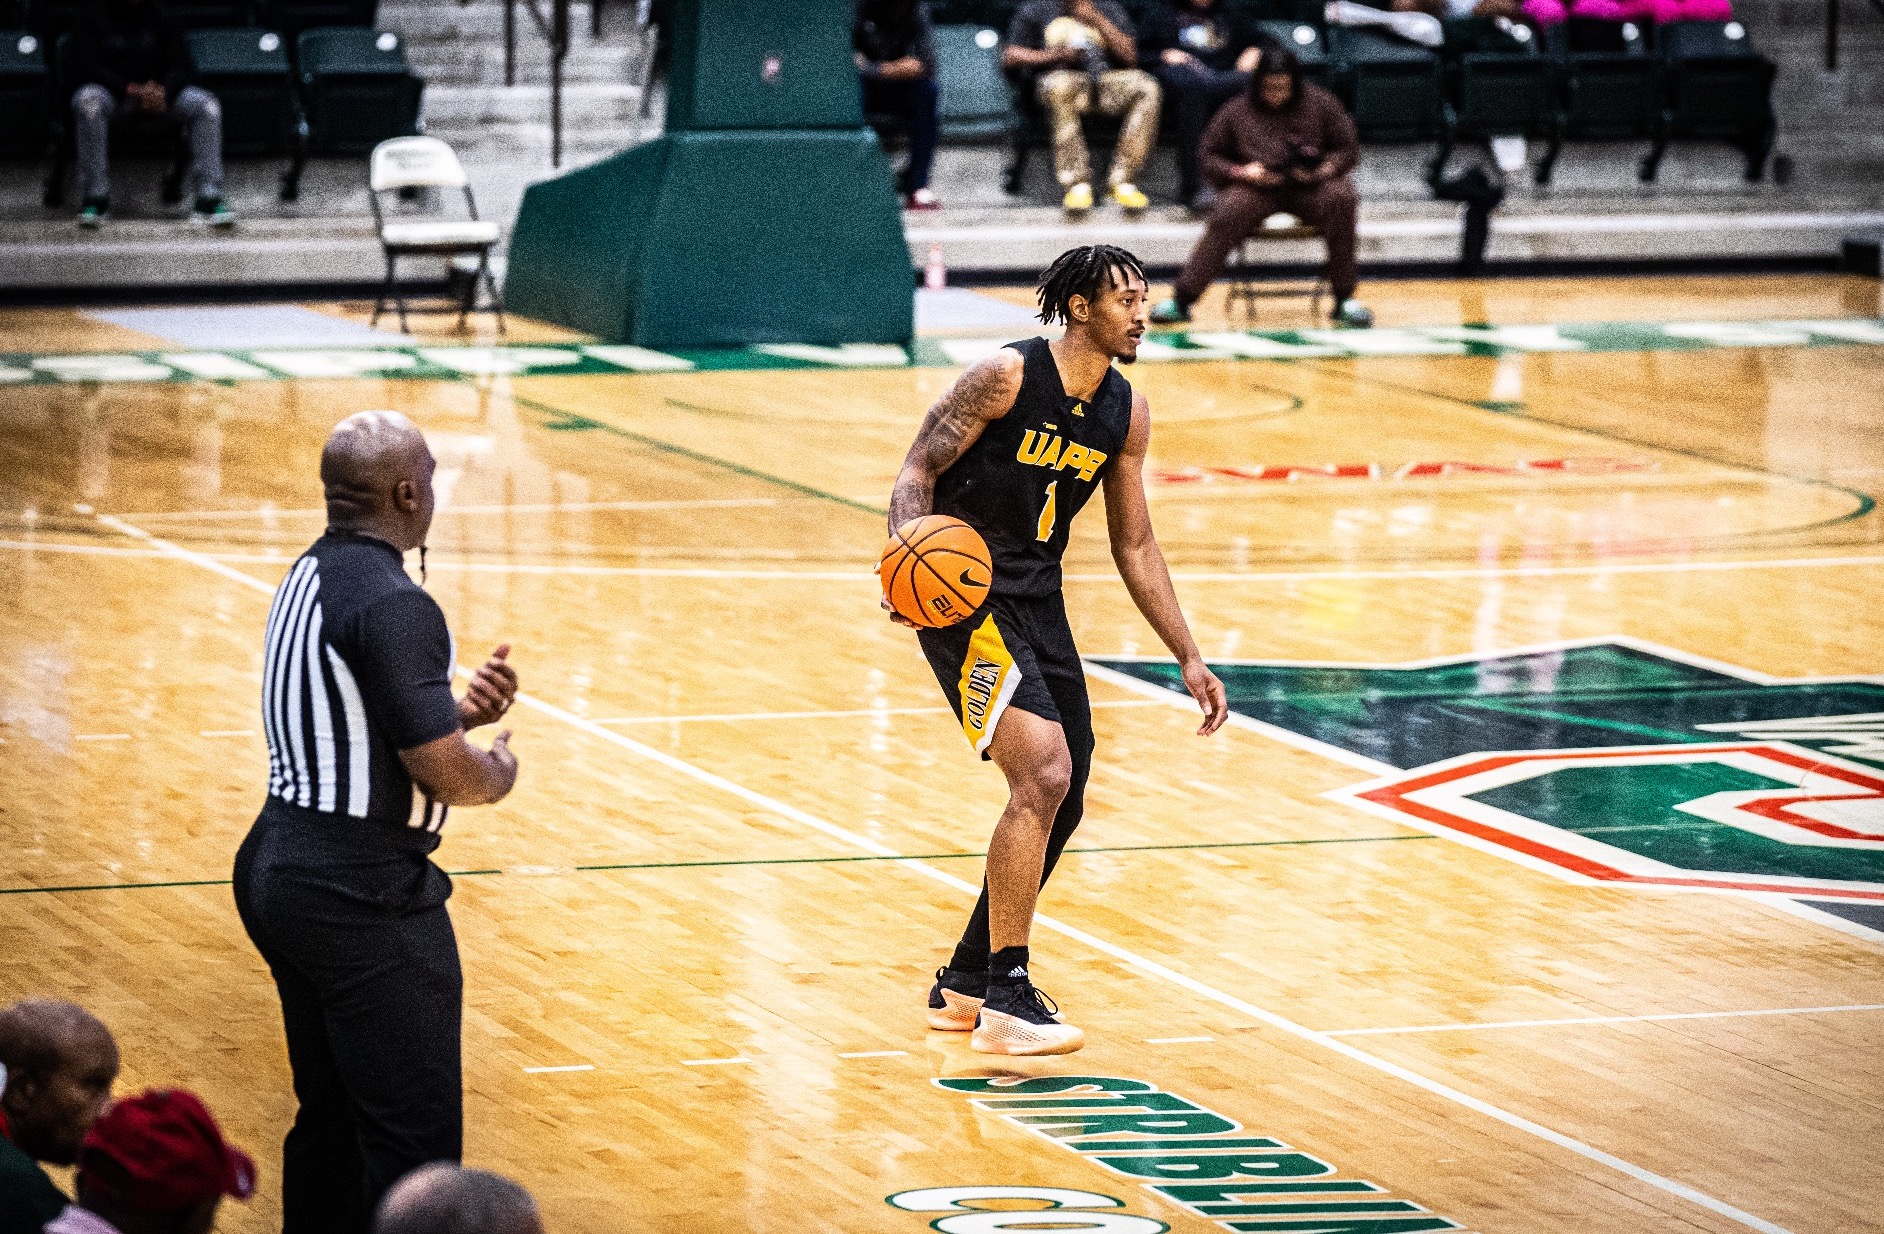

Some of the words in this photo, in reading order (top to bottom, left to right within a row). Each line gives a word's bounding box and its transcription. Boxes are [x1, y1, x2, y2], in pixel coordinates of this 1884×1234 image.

[1016, 429, 1107, 482] UAPB
[1035, 480, 1058, 542] 1
[966, 657, 1001, 730] GOLDEN
